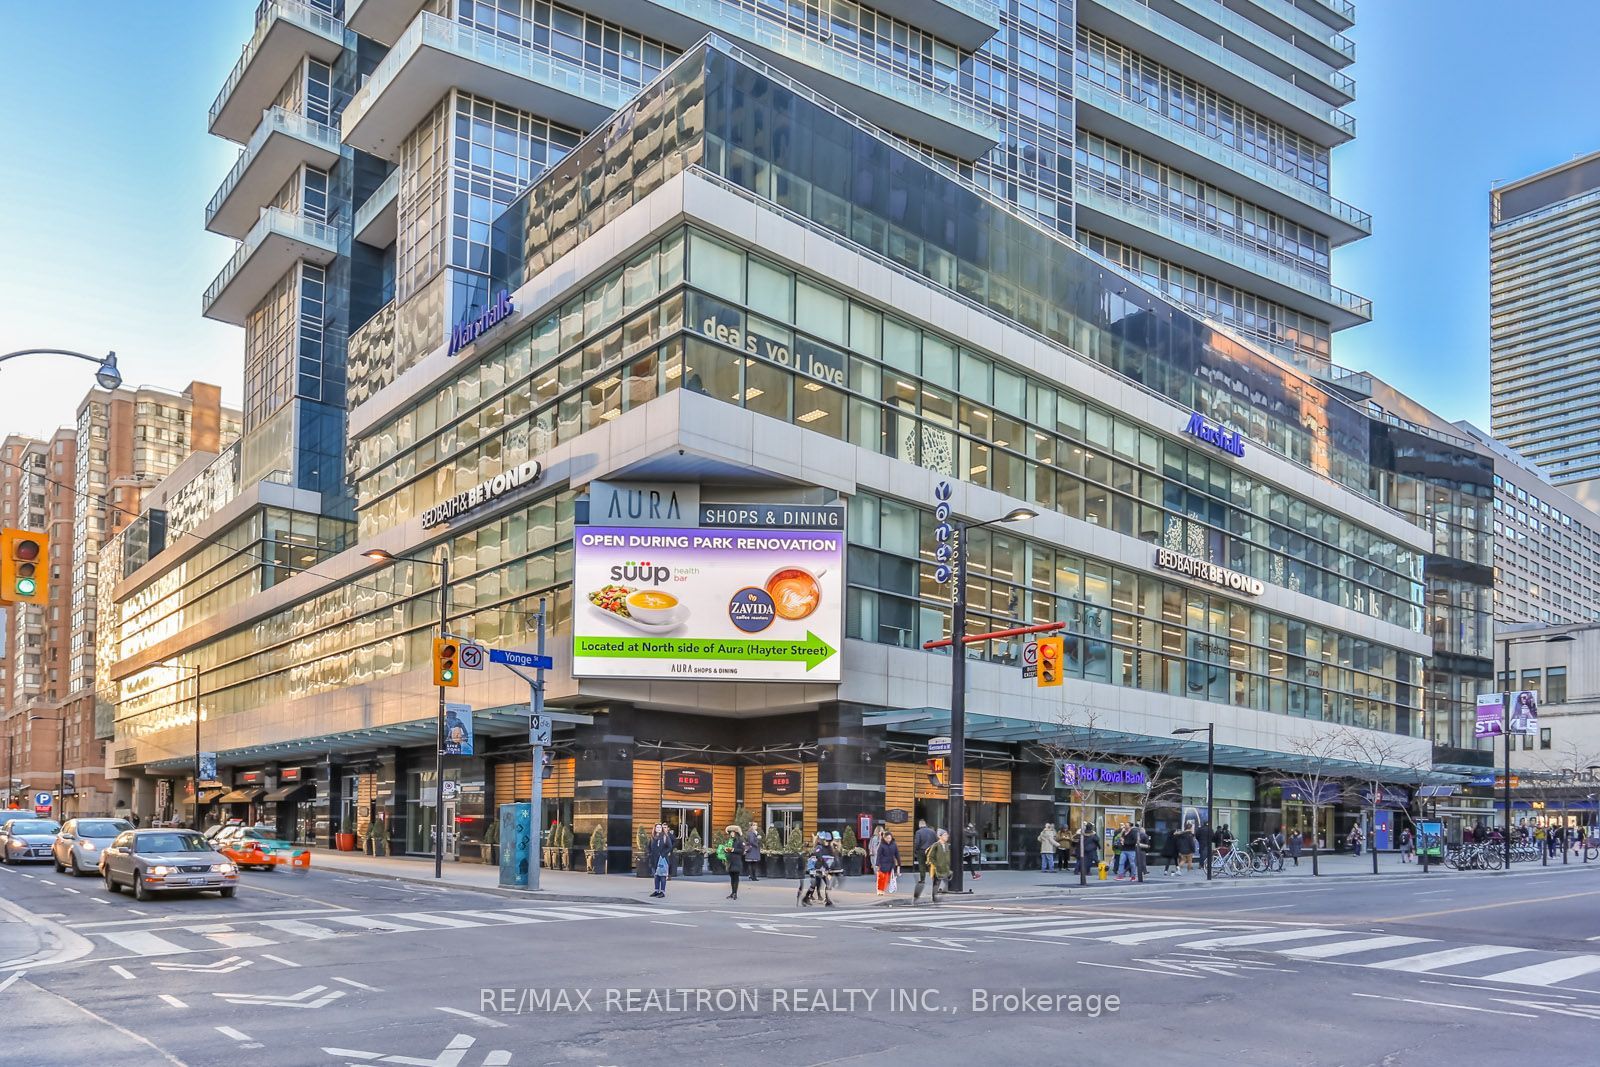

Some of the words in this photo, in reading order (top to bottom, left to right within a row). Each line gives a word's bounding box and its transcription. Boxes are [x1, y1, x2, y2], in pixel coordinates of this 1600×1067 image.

[447, 289, 514, 357] Marshalls
[808, 354, 844, 386] love
[1184, 411, 1246, 457] Marshalls
[421, 506, 437, 529] BED
[436, 494, 459, 522] BATH
[459, 492, 468, 510] &
[468, 460, 540, 508] BEYOND
[608, 489, 681, 520] AURA
[706, 509, 758, 525] SHOPS
[766, 510, 776, 525] &
[783, 510, 838, 526] DINING
[581, 534, 625, 547] OPEN
[629, 535, 689, 549] DURING
[693, 537, 732, 550] PARK
[737, 538, 836, 551] RENOVATION
[935, 480, 952, 584] Yonge
[610, 561, 671, 586] süüp
[673, 567, 700, 575] health
[951, 530, 960, 604] DOWNTOWN
[1159, 549, 1177, 569] BED
[1177, 556, 1201, 578] BATH
[1201, 563, 1209, 580] &
[1209, 566, 1265, 596] BEYOND
[731, 602, 775, 615] ZAVIDA
[504, 652, 532, 666] Yonge
[581, 641, 624, 652] Located
[628, 643, 639, 652] at
[642, 642, 675, 653] North
[677, 642, 700, 653] side
[702, 643, 715, 654] of
[717, 644, 744, 654] Aura
[747, 644, 787, 656] (Hayter
[791, 645, 828, 657] Street)
[671, 663, 693, 673] AURA
[1081, 767, 1099, 781] RBC
[1099, 769, 1123, 783] Royal
[1125, 769, 1145, 784] Bank
